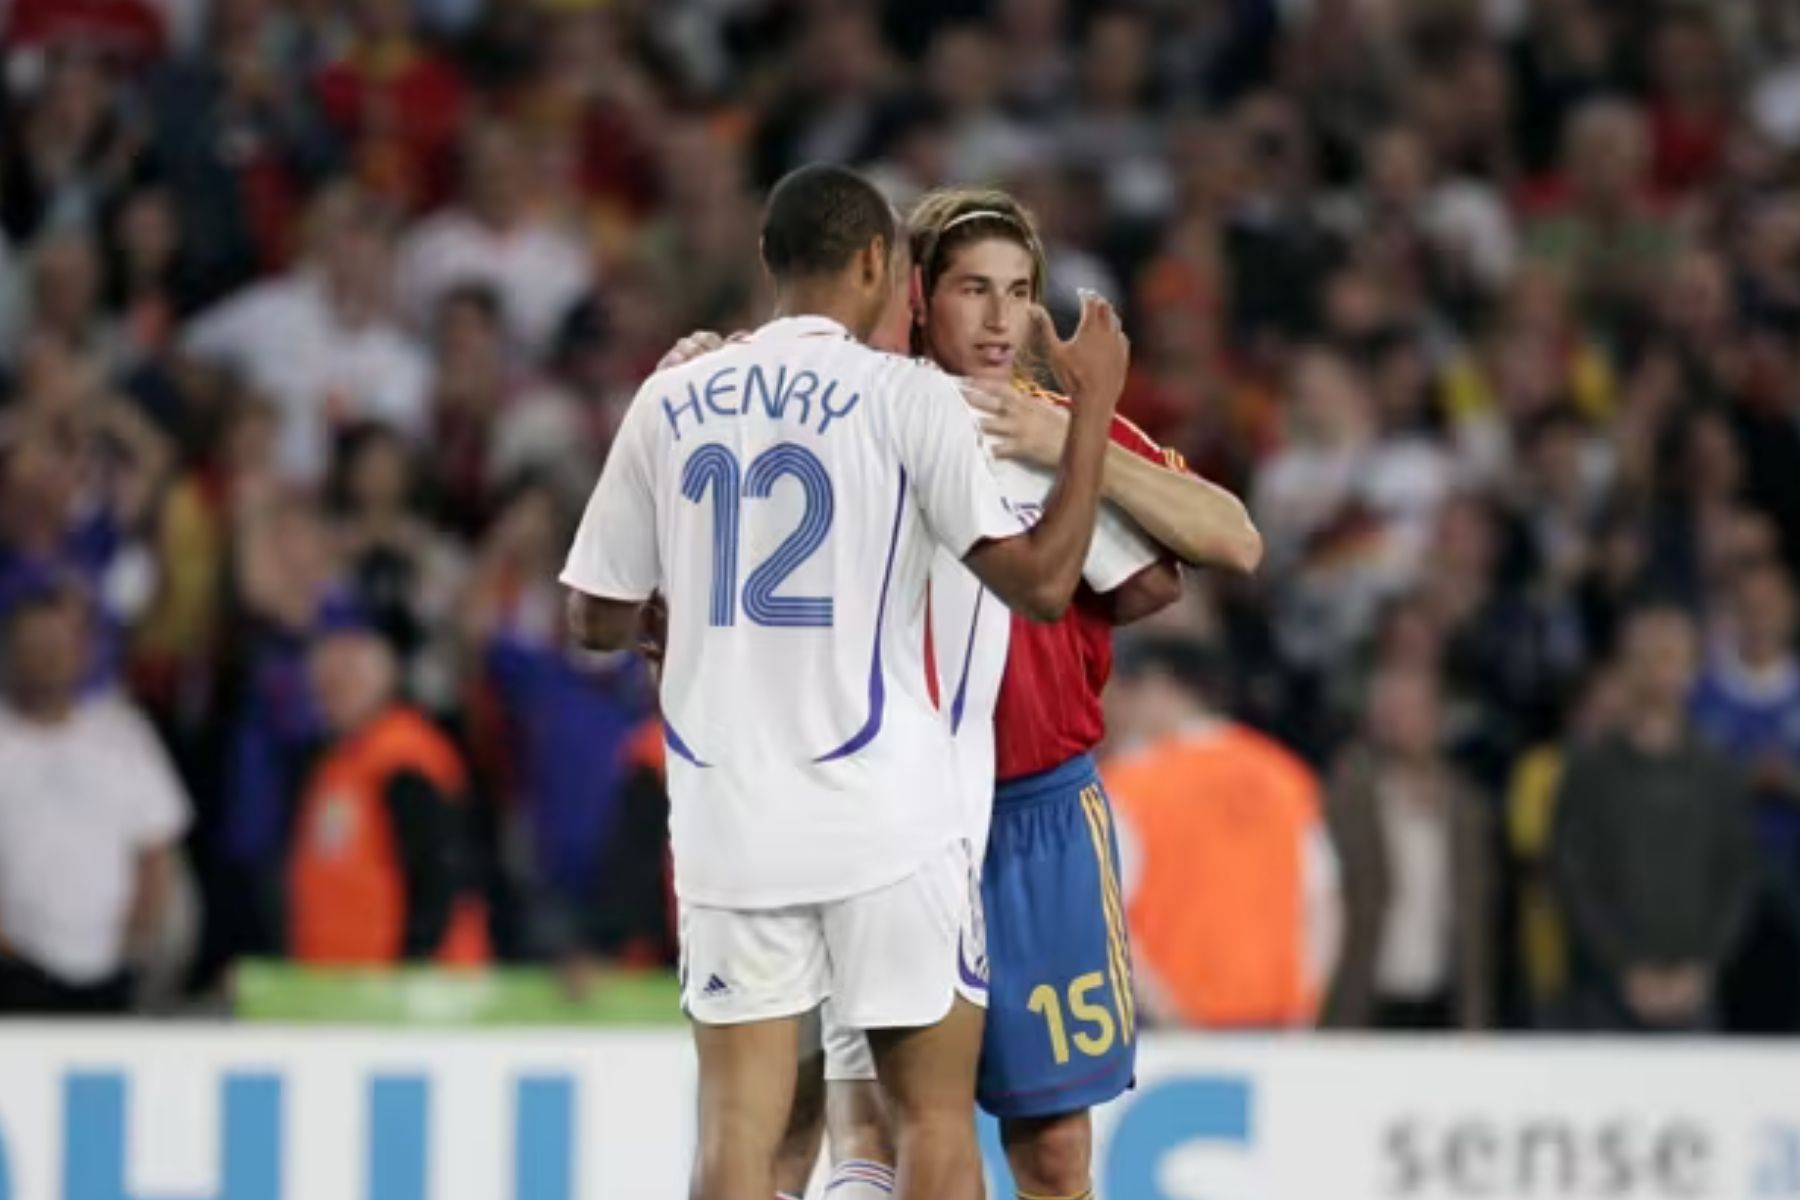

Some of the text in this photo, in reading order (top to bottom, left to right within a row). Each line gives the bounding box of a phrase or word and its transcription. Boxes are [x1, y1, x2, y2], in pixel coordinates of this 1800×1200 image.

[661, 364, 861, 441] HENRY
[681, 442, 835, 627] 12
[1026, 971, 1116, 1065] 15
[1381, 1112, 1709, 1199] sense
